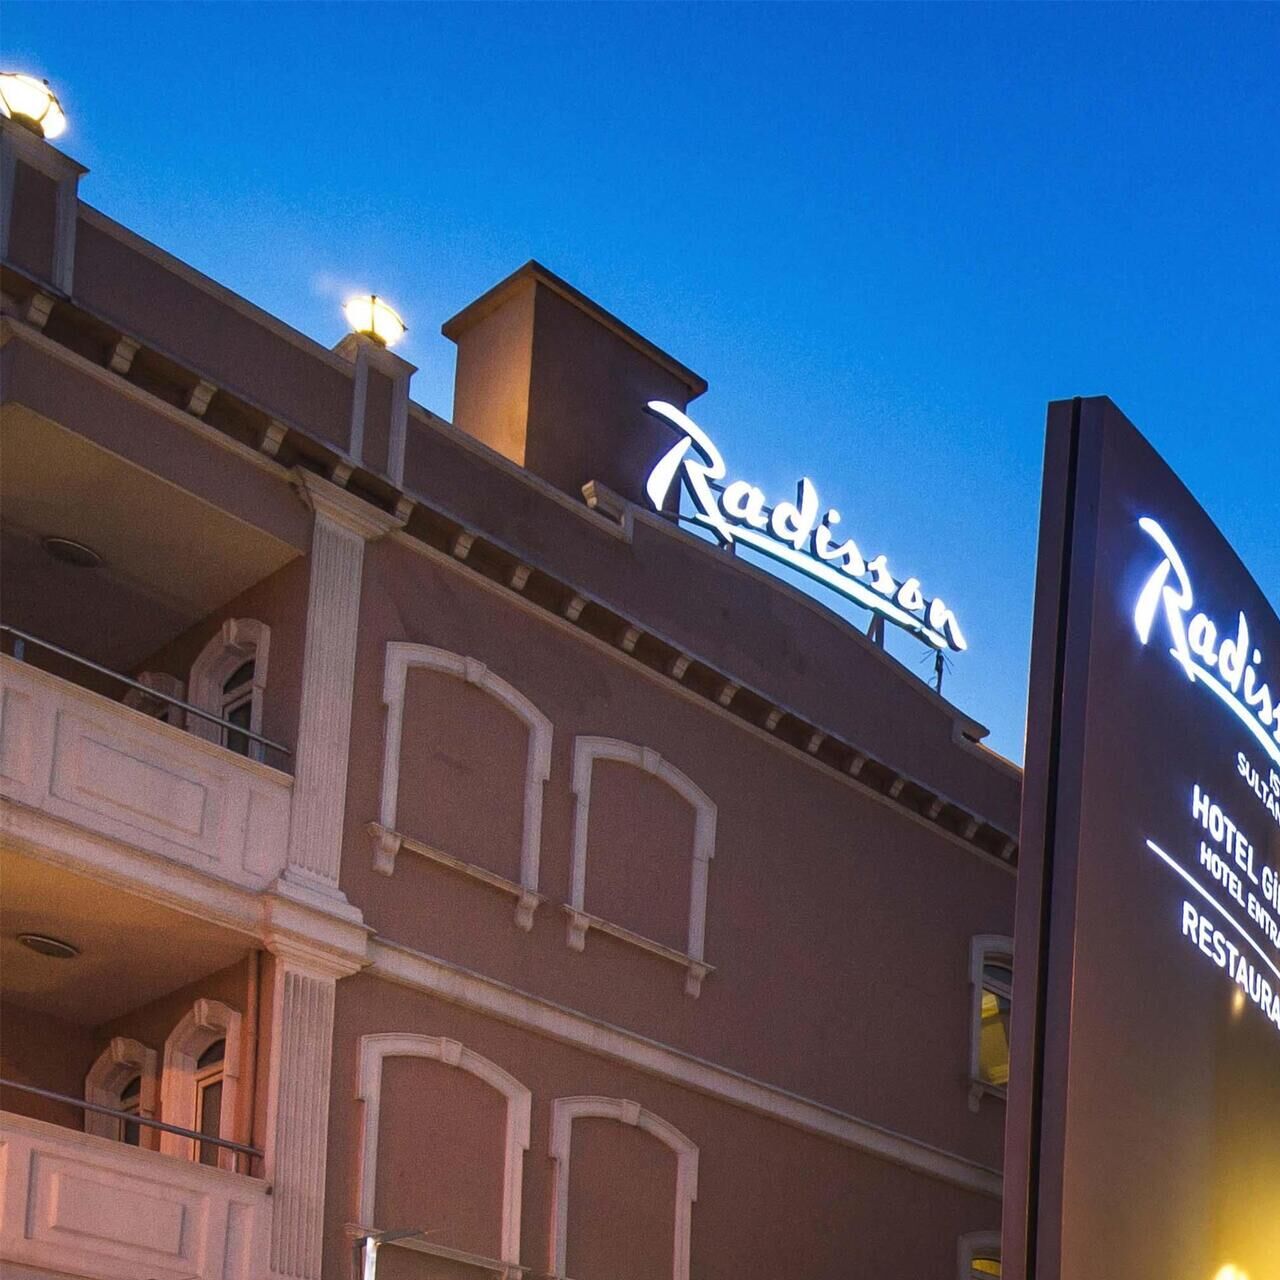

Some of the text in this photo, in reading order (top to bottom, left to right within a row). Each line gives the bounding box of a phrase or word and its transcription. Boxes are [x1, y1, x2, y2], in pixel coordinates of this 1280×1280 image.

[646, 400, 967, 651] Radisson
[1192, 784, 1258, 885] HOTEL
[1200, 841, 1245, 907] HOTEL
